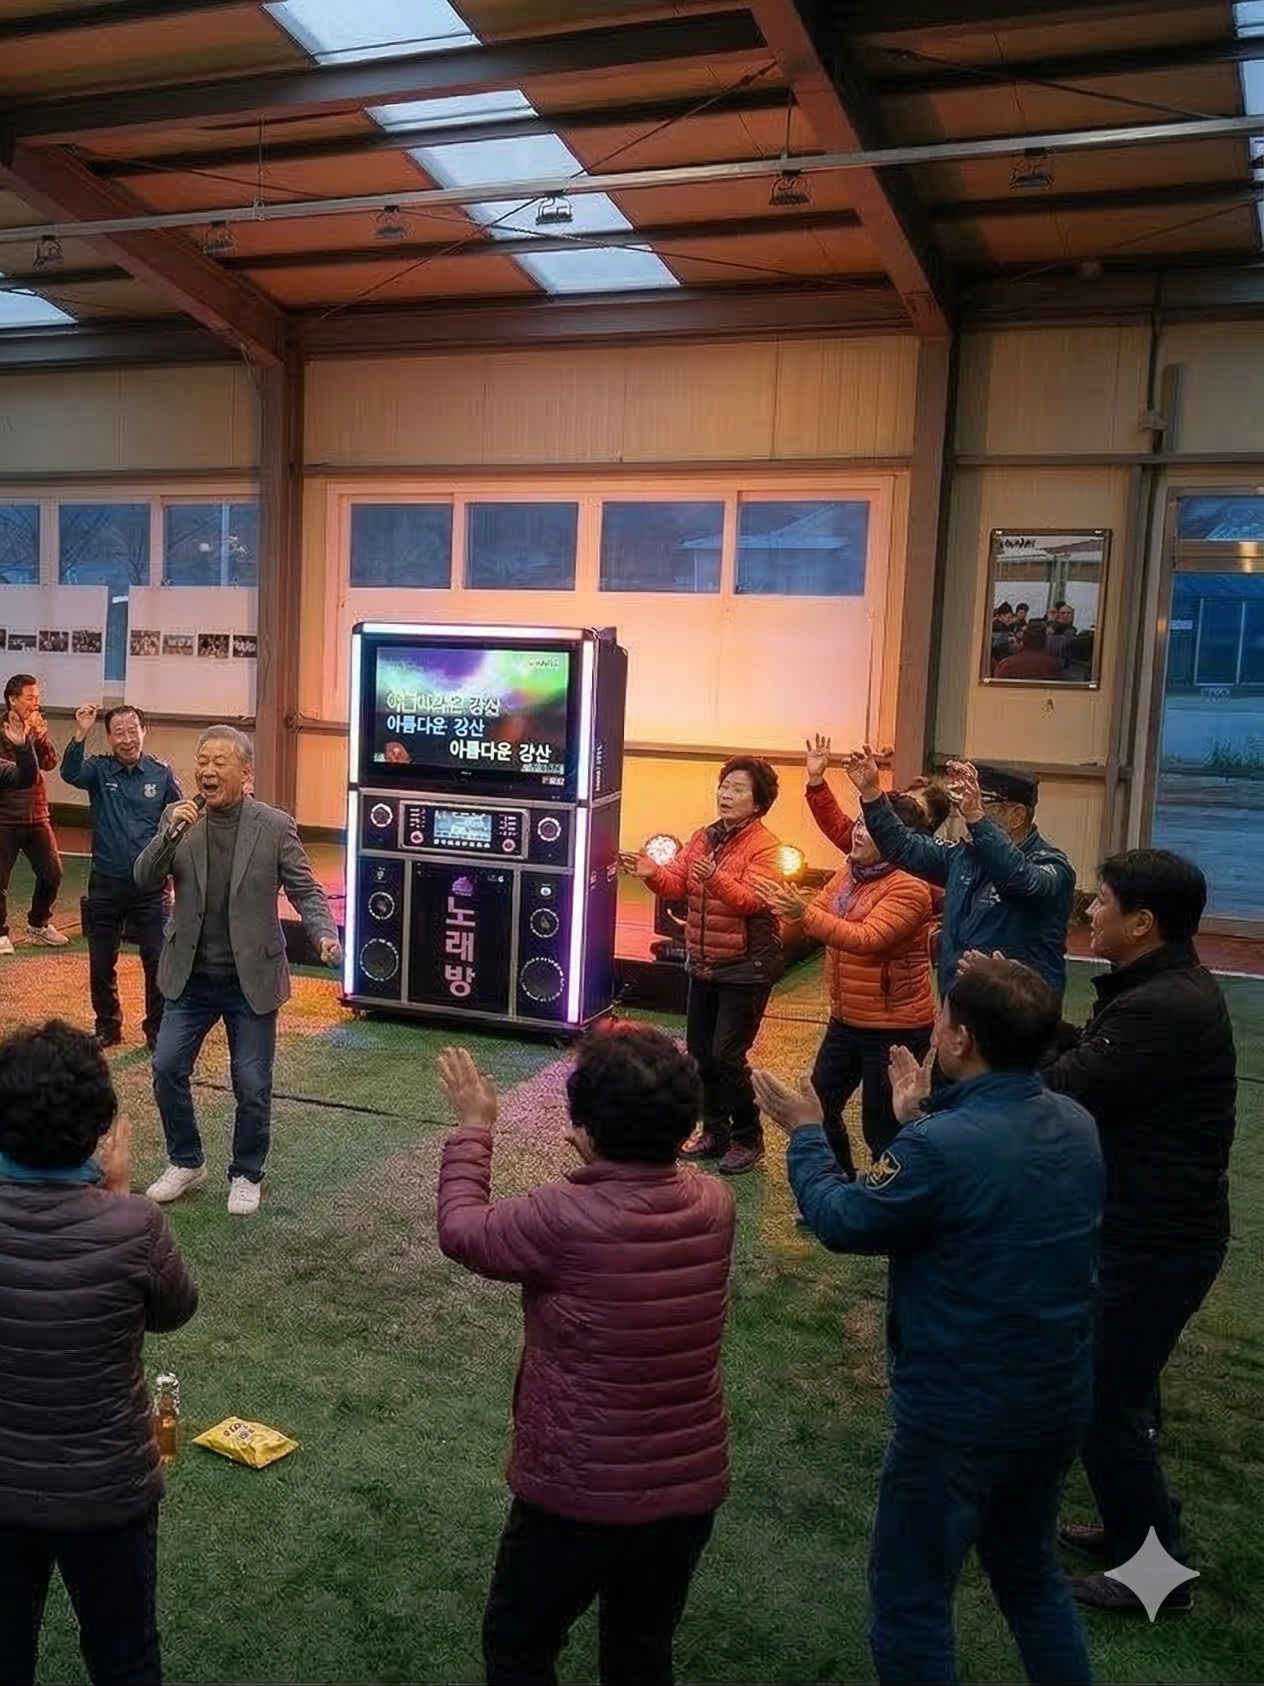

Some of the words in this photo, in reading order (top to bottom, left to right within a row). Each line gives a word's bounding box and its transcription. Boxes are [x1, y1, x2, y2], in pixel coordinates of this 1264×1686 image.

[387, 715, 448, 736] 아름다운
[453, 717, 486, 737] 강산
[449, 739, 513, 762] 아름다운
[519, 743, 552, 763] 강산
[444, 896, 476, 998] 노래방
